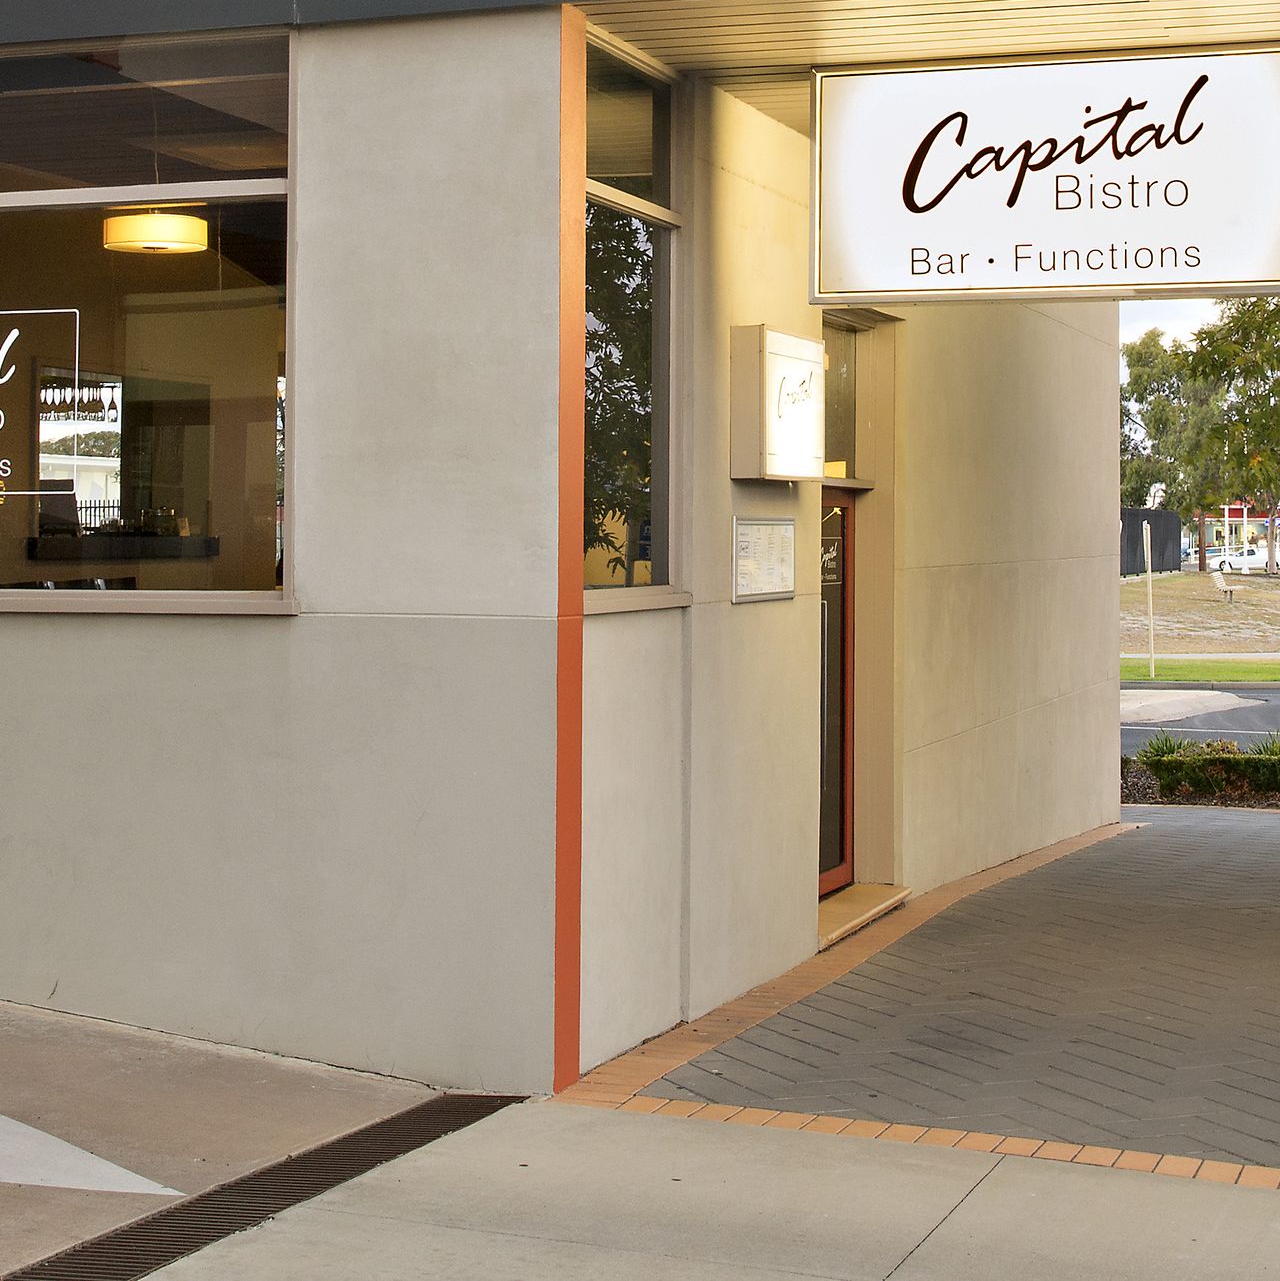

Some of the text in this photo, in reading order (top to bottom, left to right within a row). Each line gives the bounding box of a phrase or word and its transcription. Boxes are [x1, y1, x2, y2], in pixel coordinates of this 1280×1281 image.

[902, 74, 1209, 214] Capital
[1055, 174, 1189, 211] Bistro
[910, 241, 1201, 276] Bar Functions
